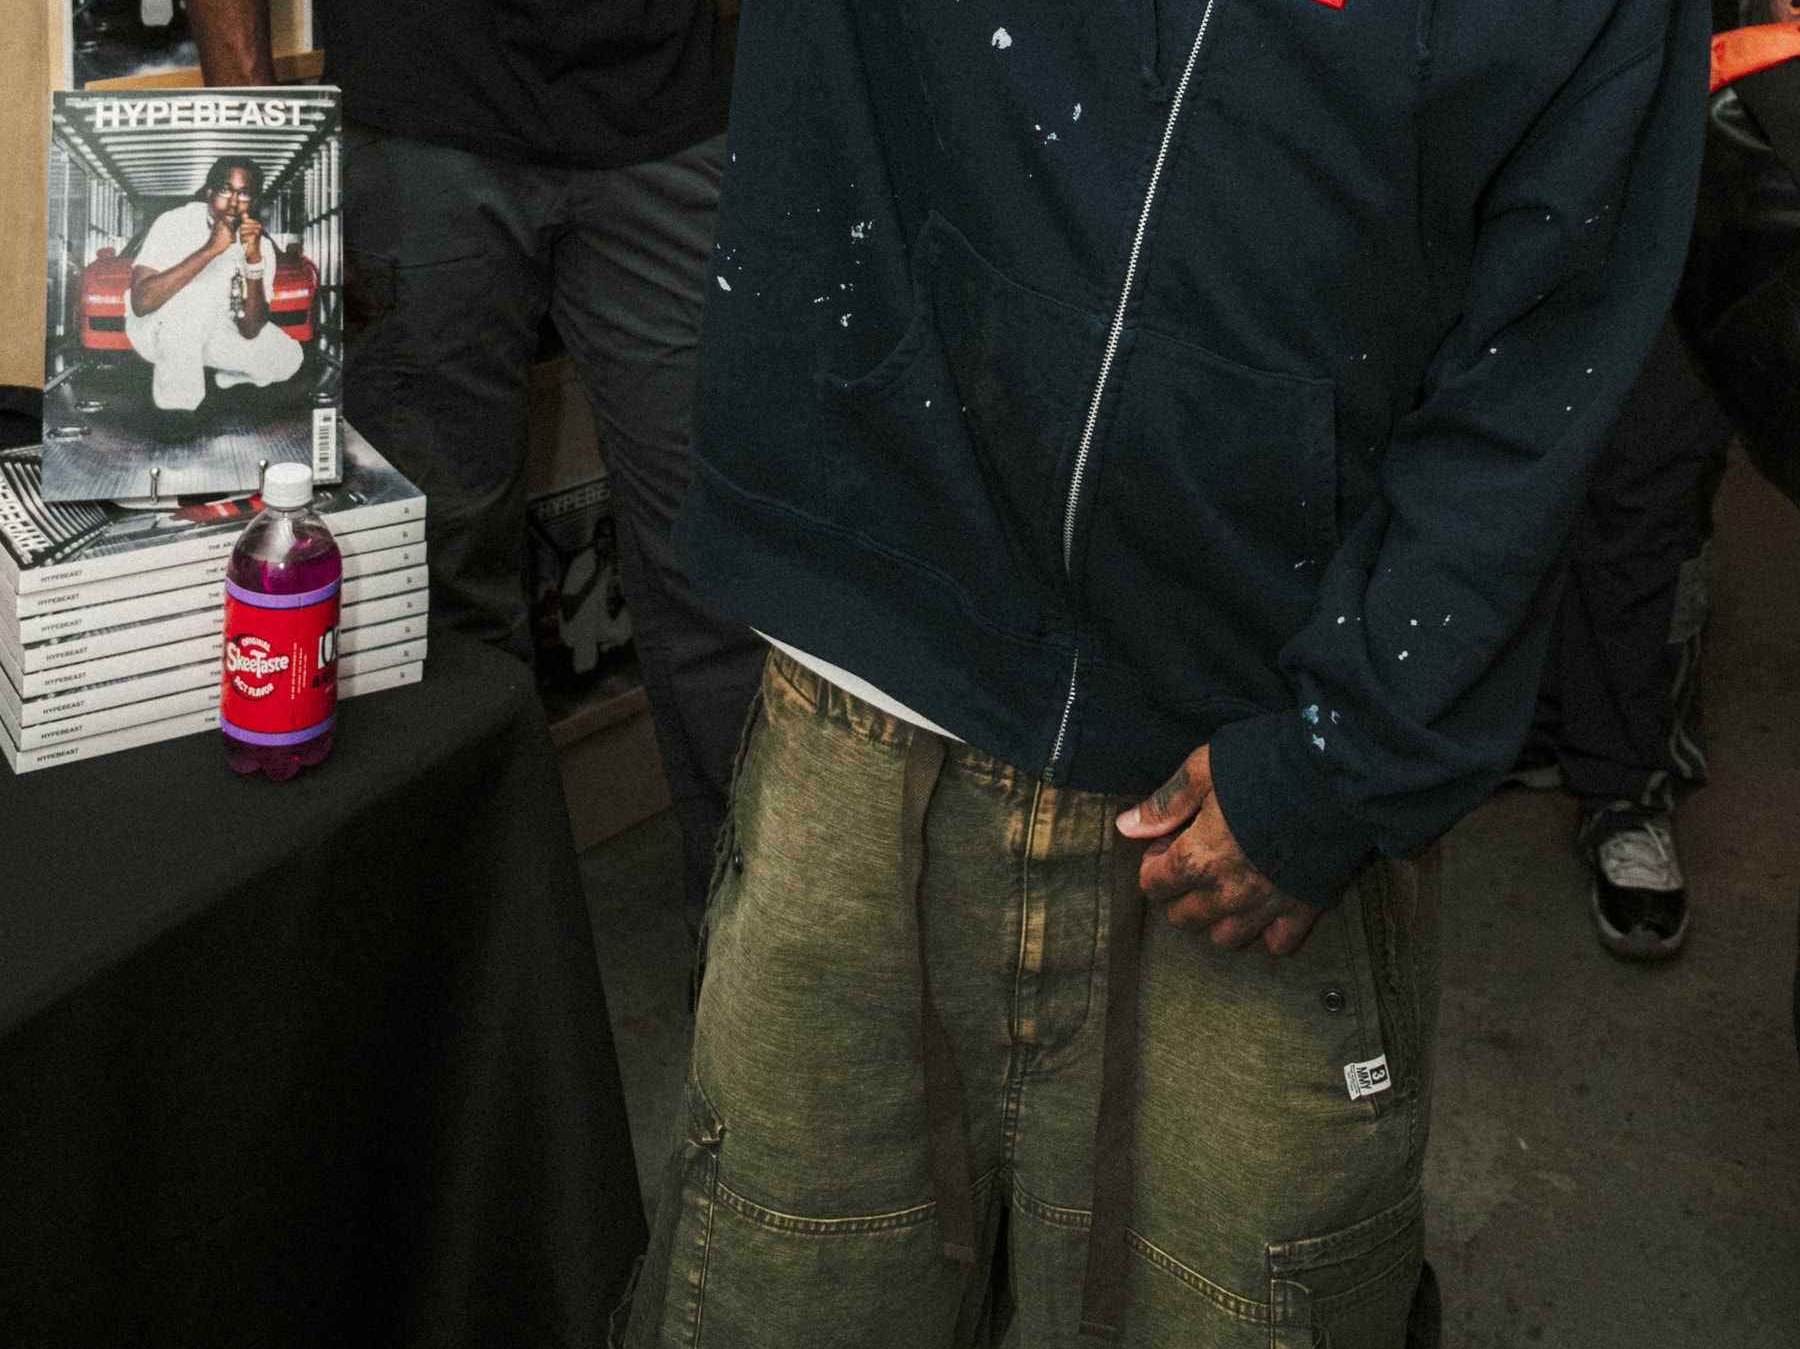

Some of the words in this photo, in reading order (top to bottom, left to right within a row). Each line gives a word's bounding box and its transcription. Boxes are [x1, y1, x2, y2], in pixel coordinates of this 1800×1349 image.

[96, 99, 307, 129] HYPEBEAST
[41, 570, 82, 583] HYPEBEAST
[38, 593, 80, 606] HYPEBEAST
[41, 619, 82, 632] HYPEBEAST
[46, 647, 88, 661] HYPEBEAST
[45, 672, 86, 686] HYPEBEAST
[247, 683, 275, 697] FLAVOR
[43, 700, 85, 715] HYPEBEAST
[41, 725, 83, 739] HYPEBEAST
[37, 747, 79, 762] HYPEBEAST
[1355, 1066, 1373, 1090] MMY
